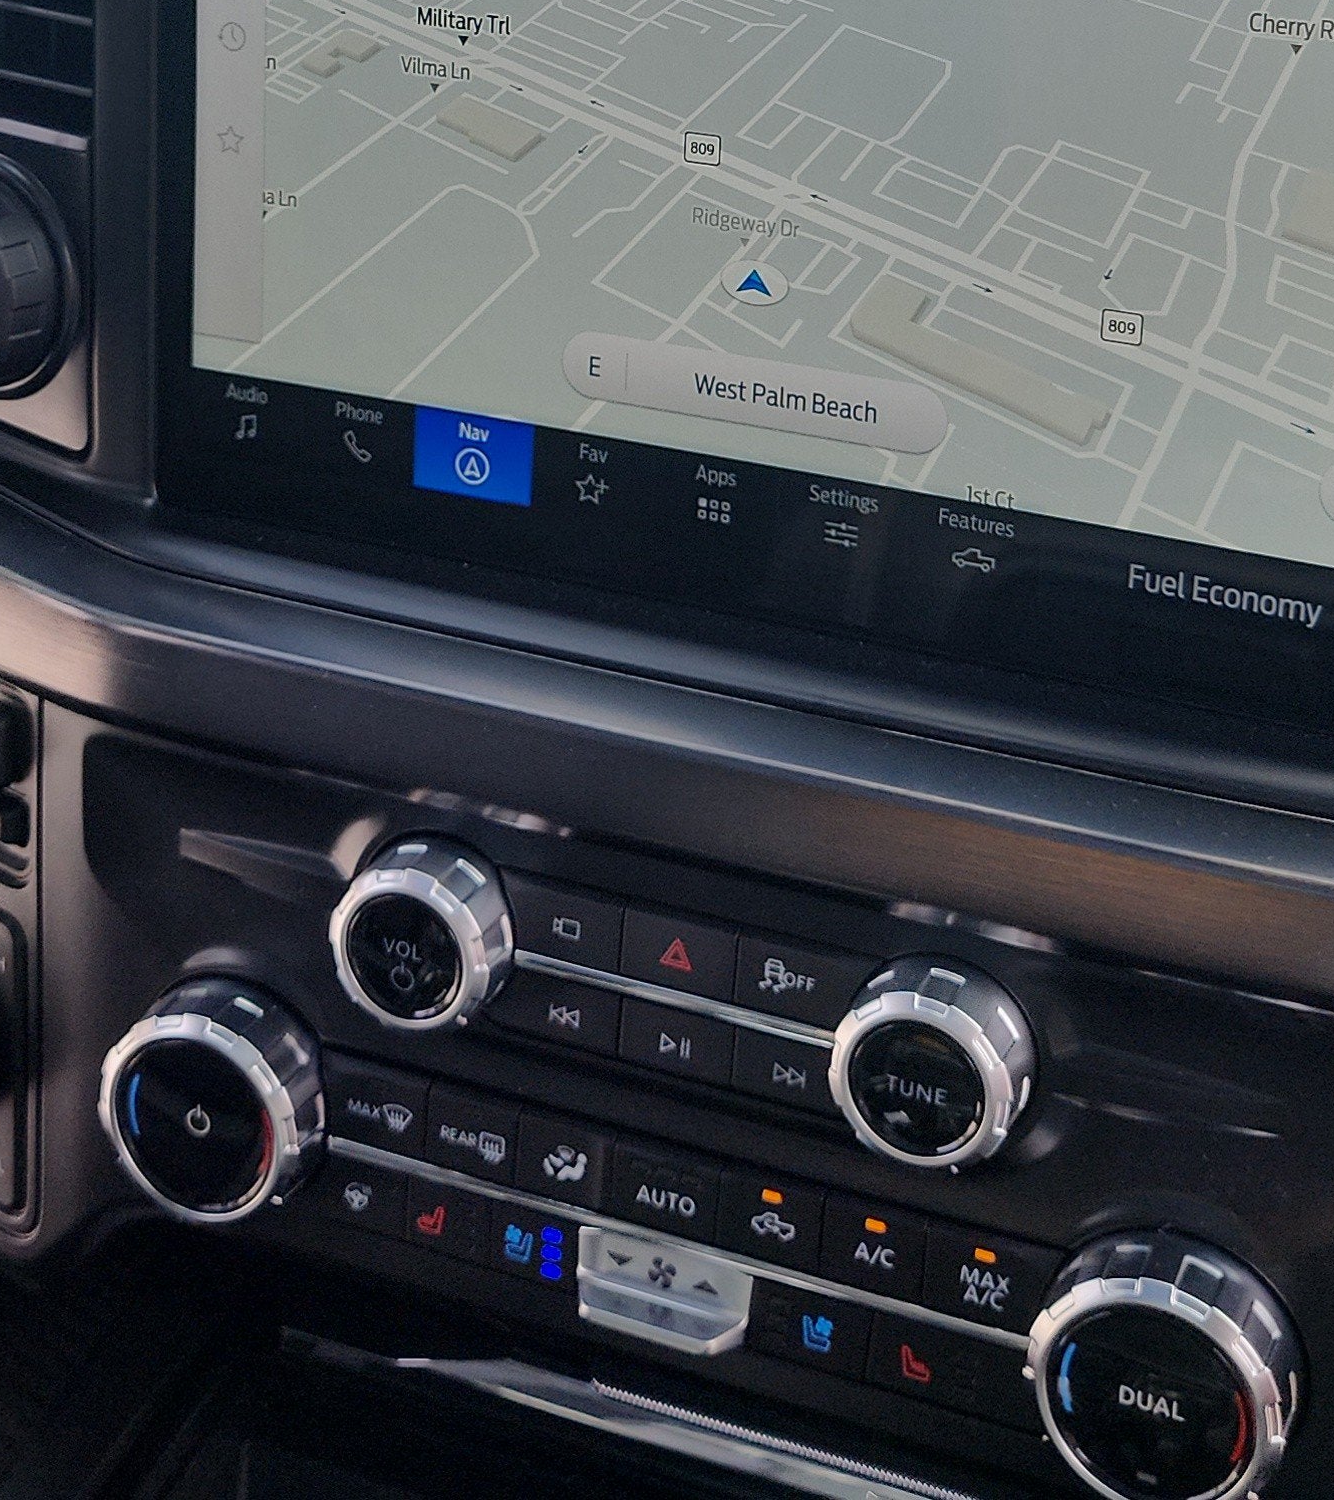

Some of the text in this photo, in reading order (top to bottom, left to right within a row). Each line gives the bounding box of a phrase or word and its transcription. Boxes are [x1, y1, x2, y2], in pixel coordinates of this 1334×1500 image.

[416, 7, 511, 35] Military Trl
[1248, 12, 1316, 41] Cherry
[400, 55, 471, 81] Vilma Ln
[690, 140, 715, 157] 809
[279, 190, 297, 207] Ln
[690, 205, 800, 240] Ridgeway Dr
[1108, 318, 1137, 338] 809
[226, 382, 269, 404] Audio
[588, 355, 879, 424] E West Palm Beach
[335, 400, 384, 425] Phone
[458, 421, 490, 443] Nav
[578, 443, 609, 464] Fav
[695, 464, 738, 489] Apps
[809, 484, 879, 514] Settings
[938, 506, 1015, 540] Features
[1127, 562, 1323, 629] Fuel Economy
[382, 937, 423, 966] VOL
[785, 971, 816, 993] OFF
[885, 1074, 948, 1106] TUNE
[347, 1098, 381, 1120] MAX
[439, 1123, 478, 1148] REAR
[635, 1184, 696, 1218] AUTO
[854, 1241, 896, 1270] A/C
[959, 1264, 1010, 1295] MAX
[963, 1284, 1004, 1312] A/C
[1117, 1384, 1186, 1423] DUAL
